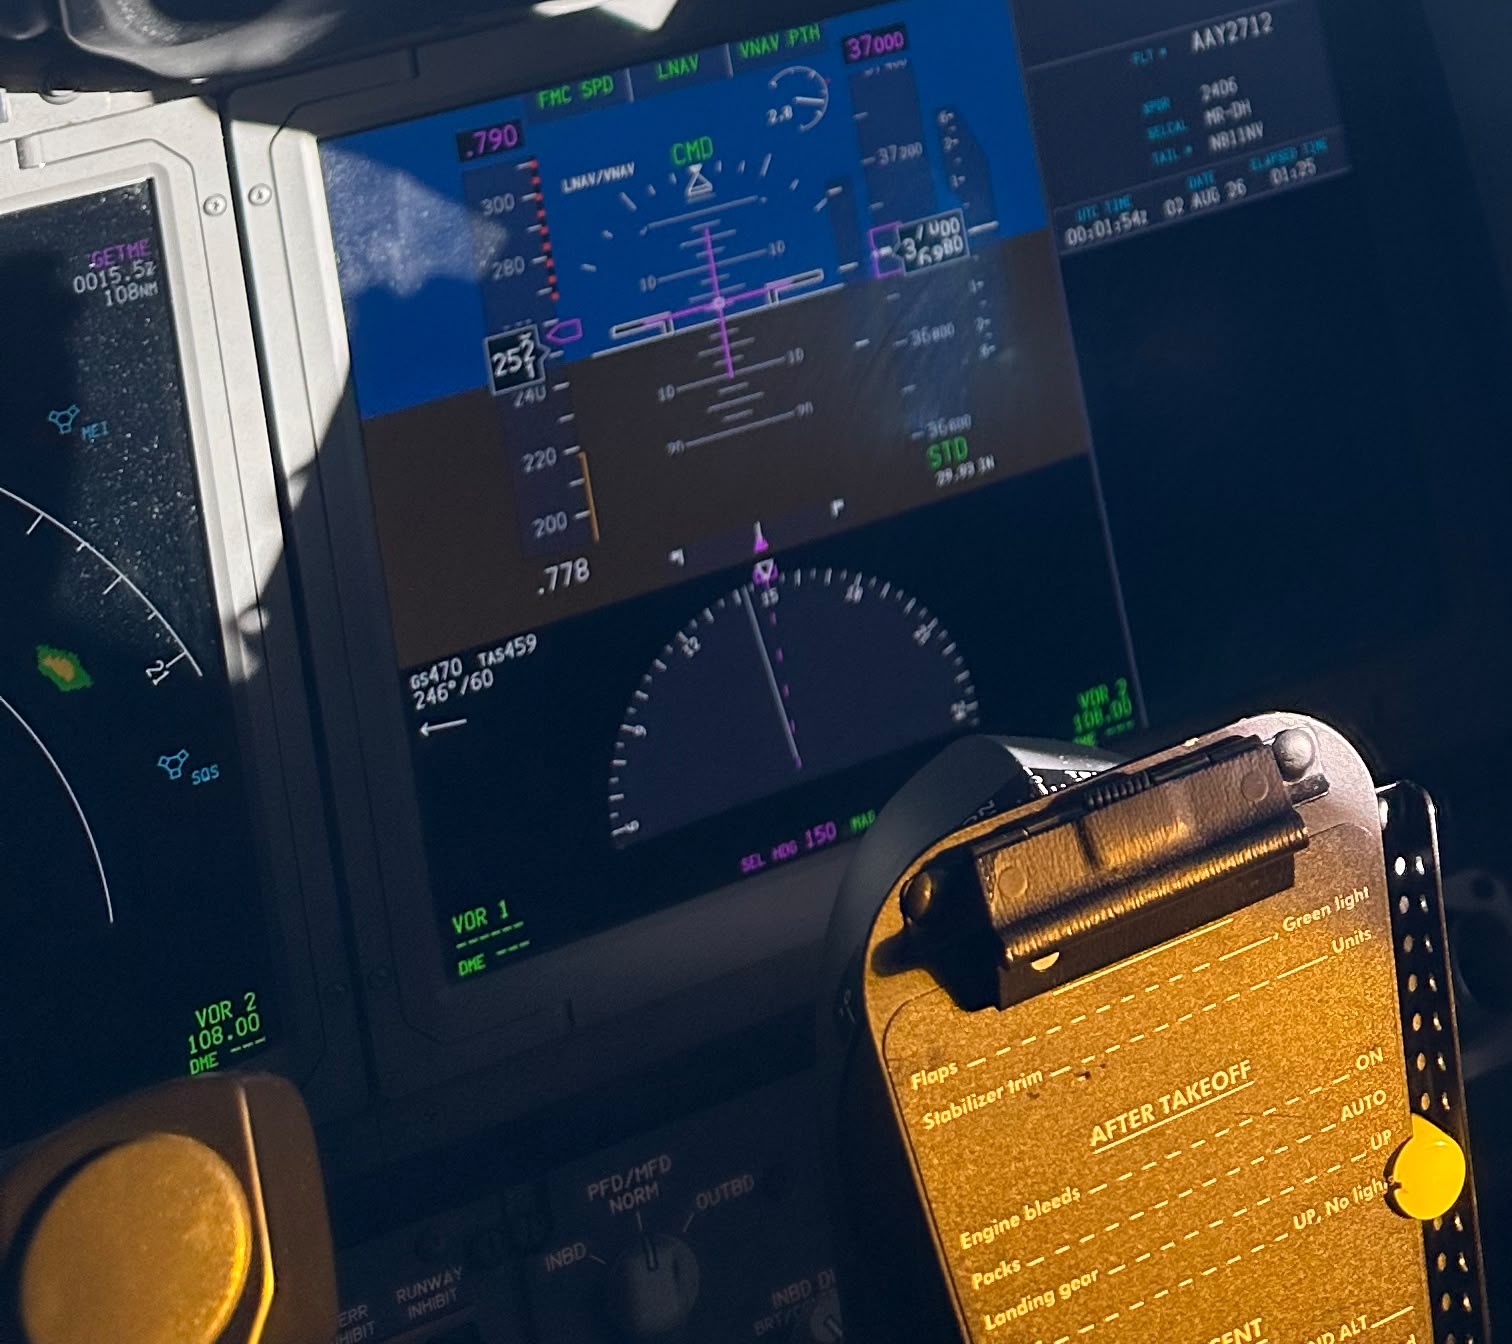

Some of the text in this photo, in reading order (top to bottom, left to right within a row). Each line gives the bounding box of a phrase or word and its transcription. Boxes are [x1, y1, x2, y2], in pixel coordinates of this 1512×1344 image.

[739, 23, 821, 59] VNAV PTH
[847, 31, 905, 60] 37000
[1190, 11, 1274, 53] AAY2712
[657, 53, 699, 81] LNAV
[537, 75, 614, 110] FMC SPD
[466, 124, 518, 157] .790
[671, 135, 714, 166] CMD
[561, 162, 635, 194] LNAV/VNAV
[482, 193, 515, 216] 300
[492, 256, 525, 280] 280
[523, 447, 557, 472] 220
[927, 436, 968, 471] STD
[531, 512, 568, 539] 200
[537, 557, 590, 595] .778
[478, 633, 537, 668] TAS459
[146, 660, 169, 686] 21
[409, 657, 463, 691] GS470
[804, 820, 838, 849] 150
[452, 899, 509, 934] VOR 1
[1283, 886, 1369, 931] Green light
[1332, 929, 1371, 953] Units
[458, 953, 486, 976] DME
[195, 992, 257, 1028] VOR 2
[189, 1013, 260, 1055] 108.00
[190, 1052, 219, 1075] DME
[1356, 1047, 1384, 1071] ON
[911, 1062, 958, 1090] Flaps
[923, 1070, 1043, 1130] Stabilizer trim
[1090, 1059, 1251, 1146] AFTER TAKEOFF
[1341, 1089, 1387, 1121] AUTO
[1370, 1129, 1391, 1150] UP
[587, 1153, 672, 1202] PFD/MFD
[695, 1174, 755, 1212] OUTBD
[608, 1183, 660, 1215] NORM
[1293, 1208, 1321, 1230] UP,
[1325, 1196, 1349, 1216] No
[960, 1186, 1080, 1250] Engine bleeds
[544, 1242, 587, 1272] INBD
[395, 1264, 463, 1305] RUNWAY
[972, 1260, 1021, 1290] Packs
[338, 1304, 369, 1328] ERR
[408, 1287, 458, 1320] INHIBIT
[984, 1269, 1098, 1331] Landing gear
[1339, 1315, 1368, 1342] ALT
